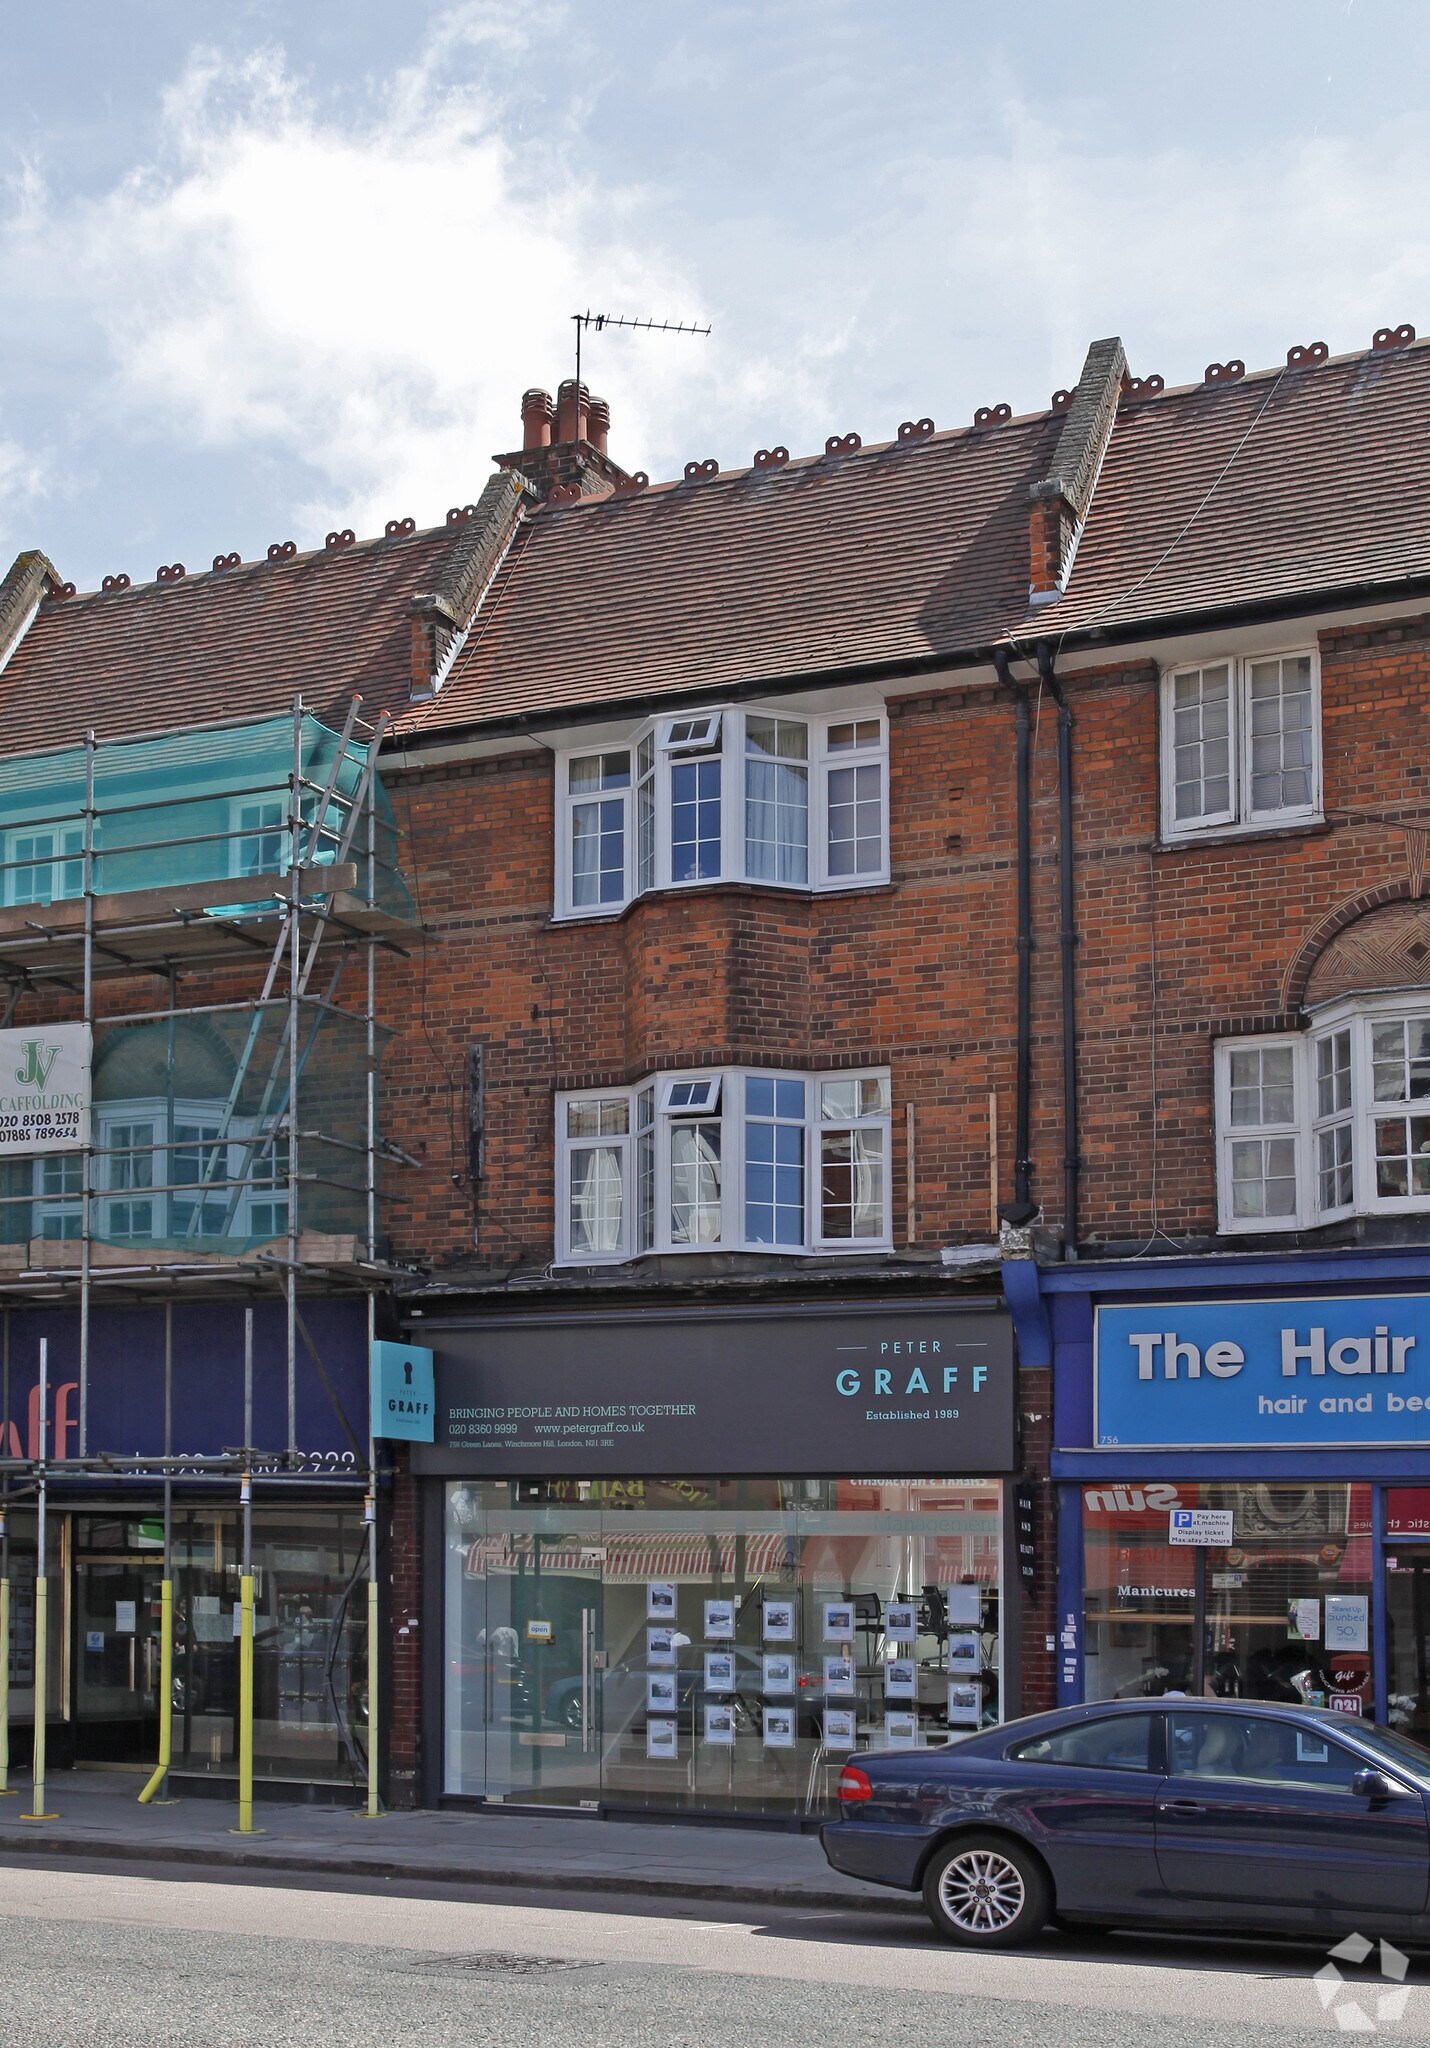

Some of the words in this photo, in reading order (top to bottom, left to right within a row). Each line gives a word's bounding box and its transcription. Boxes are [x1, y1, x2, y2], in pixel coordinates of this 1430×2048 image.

[22, 1113, 51, 1127] 8508
[55, 1111, 79, 1126] 2578
[0, 1128, 31, 1142] 07885
[35, 1127, 78, 1140] 789654
[880, 1340, 941, 1354] PETER
[1128, 1331, 1245, 1381] The
[1280, 1325, 1416, 1377] Hair
[835, 1366, 988, 1396] GRAFF
[388, 1399, 429, 1415] GRAFF
[1258, 1394, 1308, 1415] hair
[1318, 1392, 1373, 1413] and
[449, 1407, 505, 1419] BRINGING
[507, 1407, 552, 1418] PEOPLE
[554, 1406, 580, 1418] AND
[582, 1406, 627, 1417] HOMES
[628, 1404, 697, 1416] TOGETHER
[865, 1410, 930, 1420] Established
[934, 1409, 959, 1419] 1989
[448, 1424, 466, 1435] 020
[468, 1424, 492, 1435] 8360
[494, 1423, 518, 1434] 9999
[534, 1421, 645, 1435] www.petergraff.co.uk
[461, 1440, 481, 1448] Green
[504, 1440, 541, 1448] Winchmore
[557, 1440, 584, 1448] London,
[585, 1439, 598, 1447] N21
[600, 1439, 614, 1447] 3RE
[1100, 1435, 1119, 1444] 756
[1019, 1499, 1031, 1510] HAIR
[1196, 1513, 1209, 1521] Pay
[873, 1515, 999, 1533] Management
[1021, 1521, 1031, 1532] AND
[1020, 1544, 1034, 1555] BEAUTY
[1117, 1585, 1196, 1598] Manicures
[1332, 1605, 1352, 1613] Stand
[1327, 1613, 1365, 1622] Sunbed
[1335, 1670, 1355, 1683] Gift
